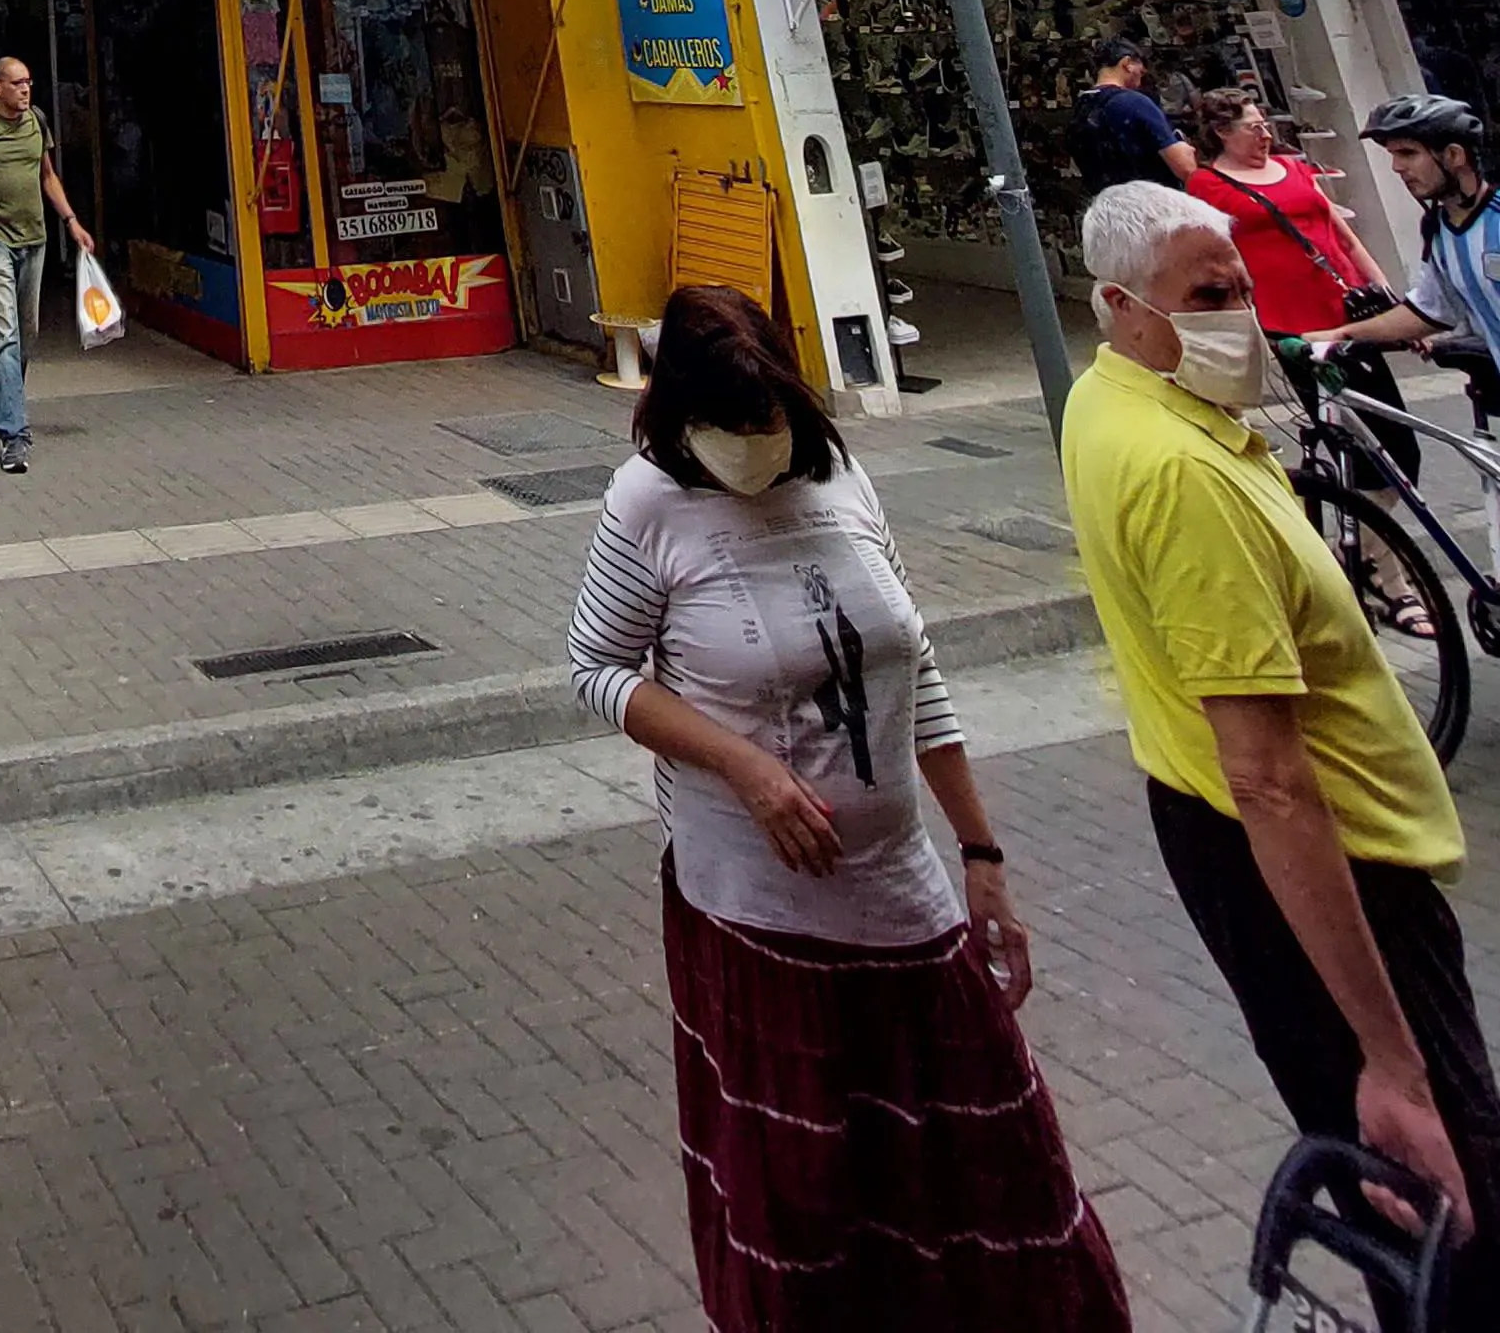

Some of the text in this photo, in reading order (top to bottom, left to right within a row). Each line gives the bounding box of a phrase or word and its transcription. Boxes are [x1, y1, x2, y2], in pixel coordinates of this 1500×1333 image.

[642, 37, 725, 69] CABALLEROS
[339, 209, 436, 238] 3516889718
[347, 260, 459, 307] BOOMBA!
